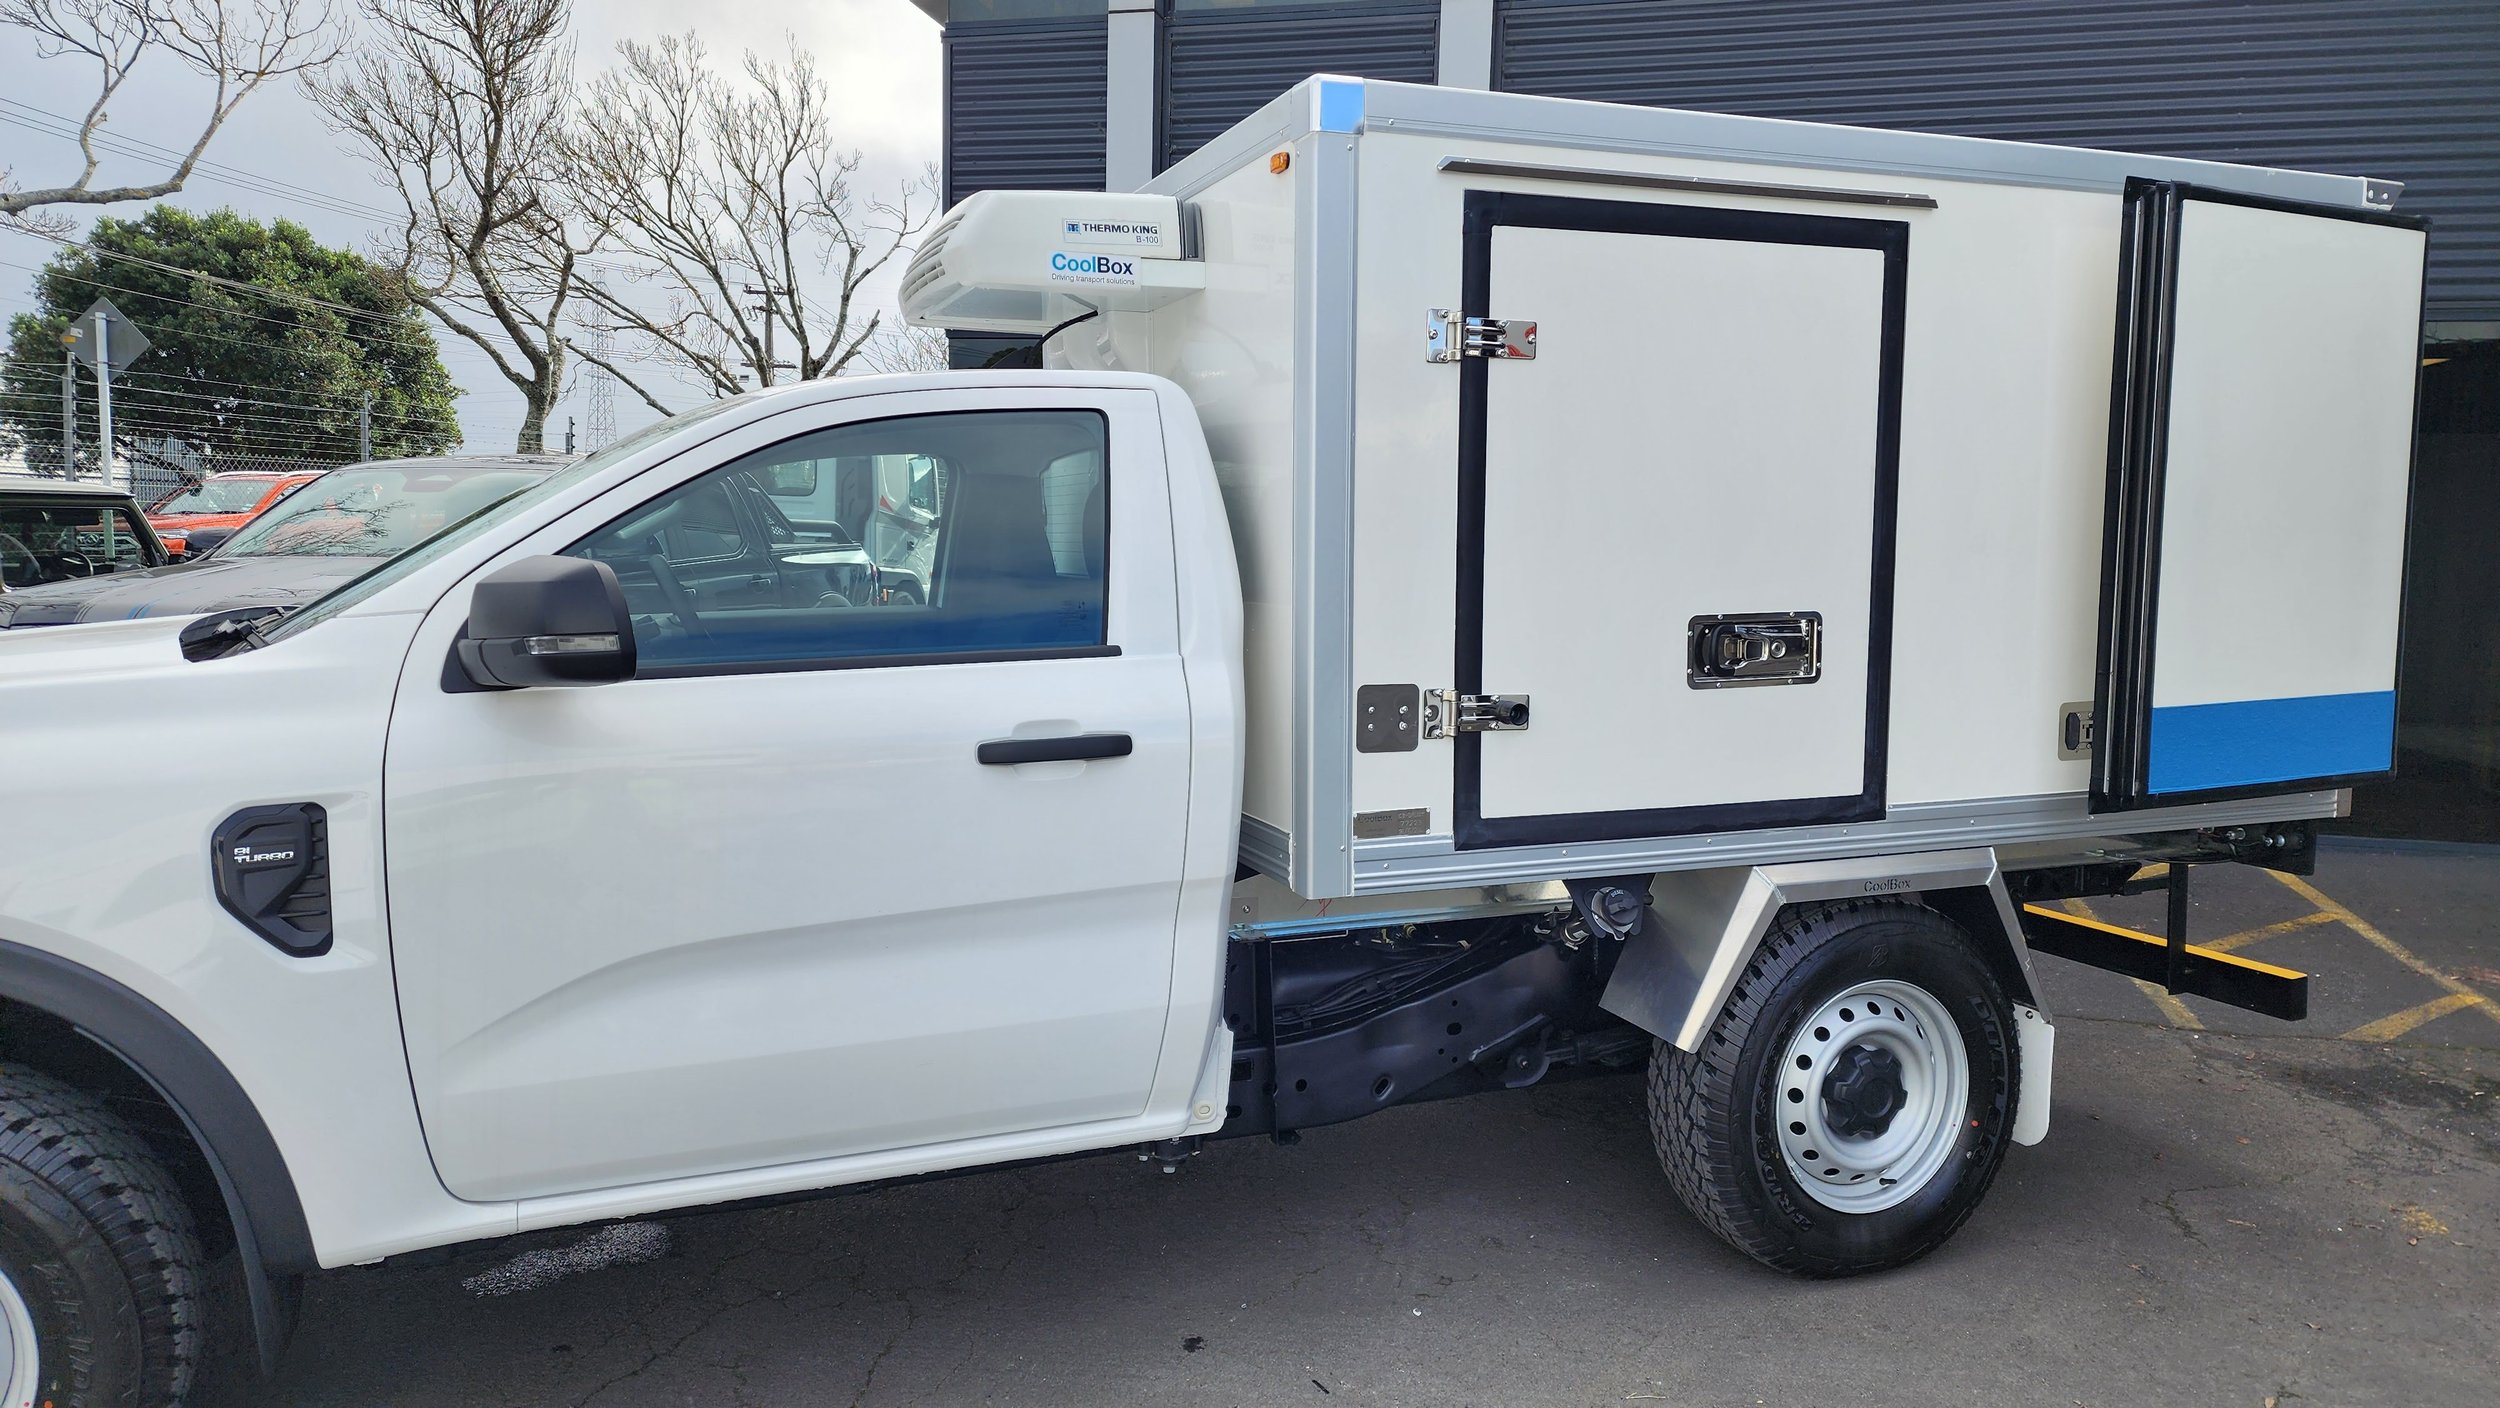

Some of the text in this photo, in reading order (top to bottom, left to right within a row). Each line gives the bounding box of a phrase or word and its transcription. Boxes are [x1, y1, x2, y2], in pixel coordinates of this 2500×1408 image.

[1082, 223, 1158, 235] THERMO KING
[1051, 253, 1134, 275] CoolBox
[1051, 273, 1135, 286] Driving transport solutions
[233, 847, 251, 856] BI
[233, 851, 295, 864] TURBO
[1863, 878, 1912, 892] CoolBox
